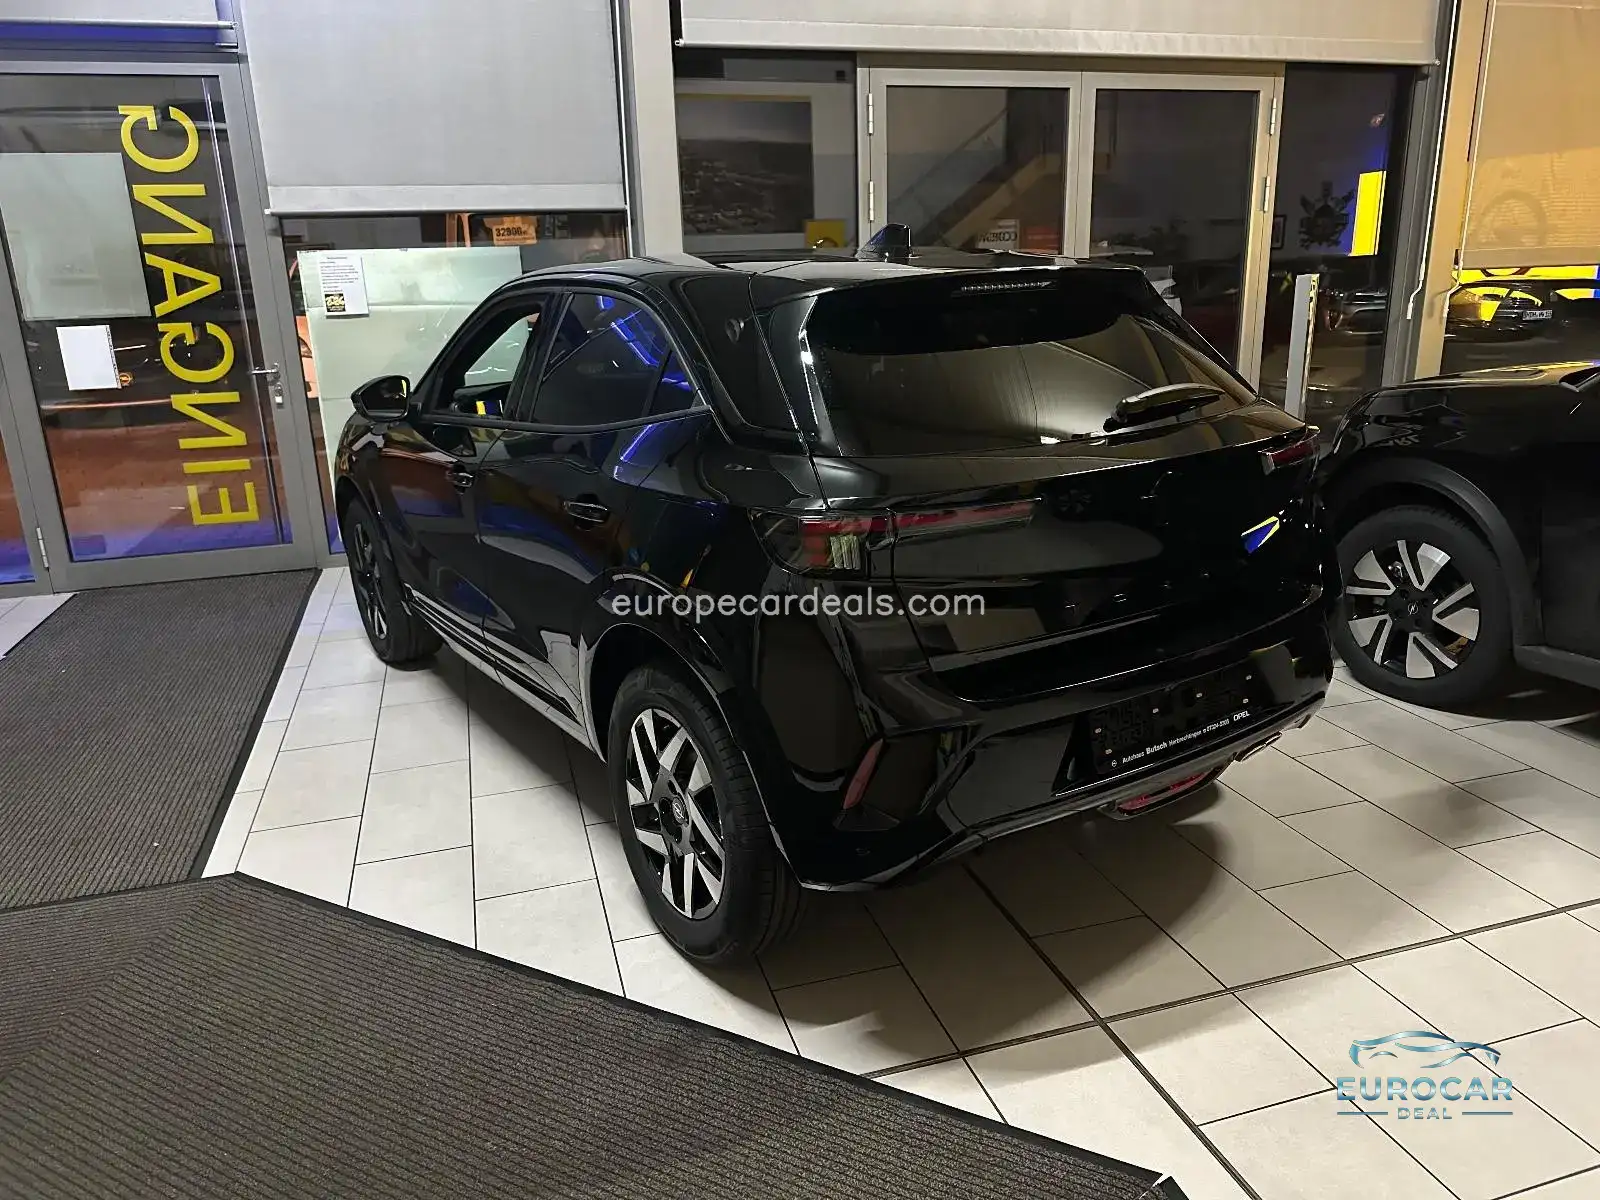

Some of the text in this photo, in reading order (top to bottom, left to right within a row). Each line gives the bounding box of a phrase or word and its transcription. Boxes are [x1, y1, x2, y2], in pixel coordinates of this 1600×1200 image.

[1122, 751, 1145, 763] Autohaus
[1145, 741, 1168, 755] Butsch
[1233, 710, 1250, 722] OPEL
